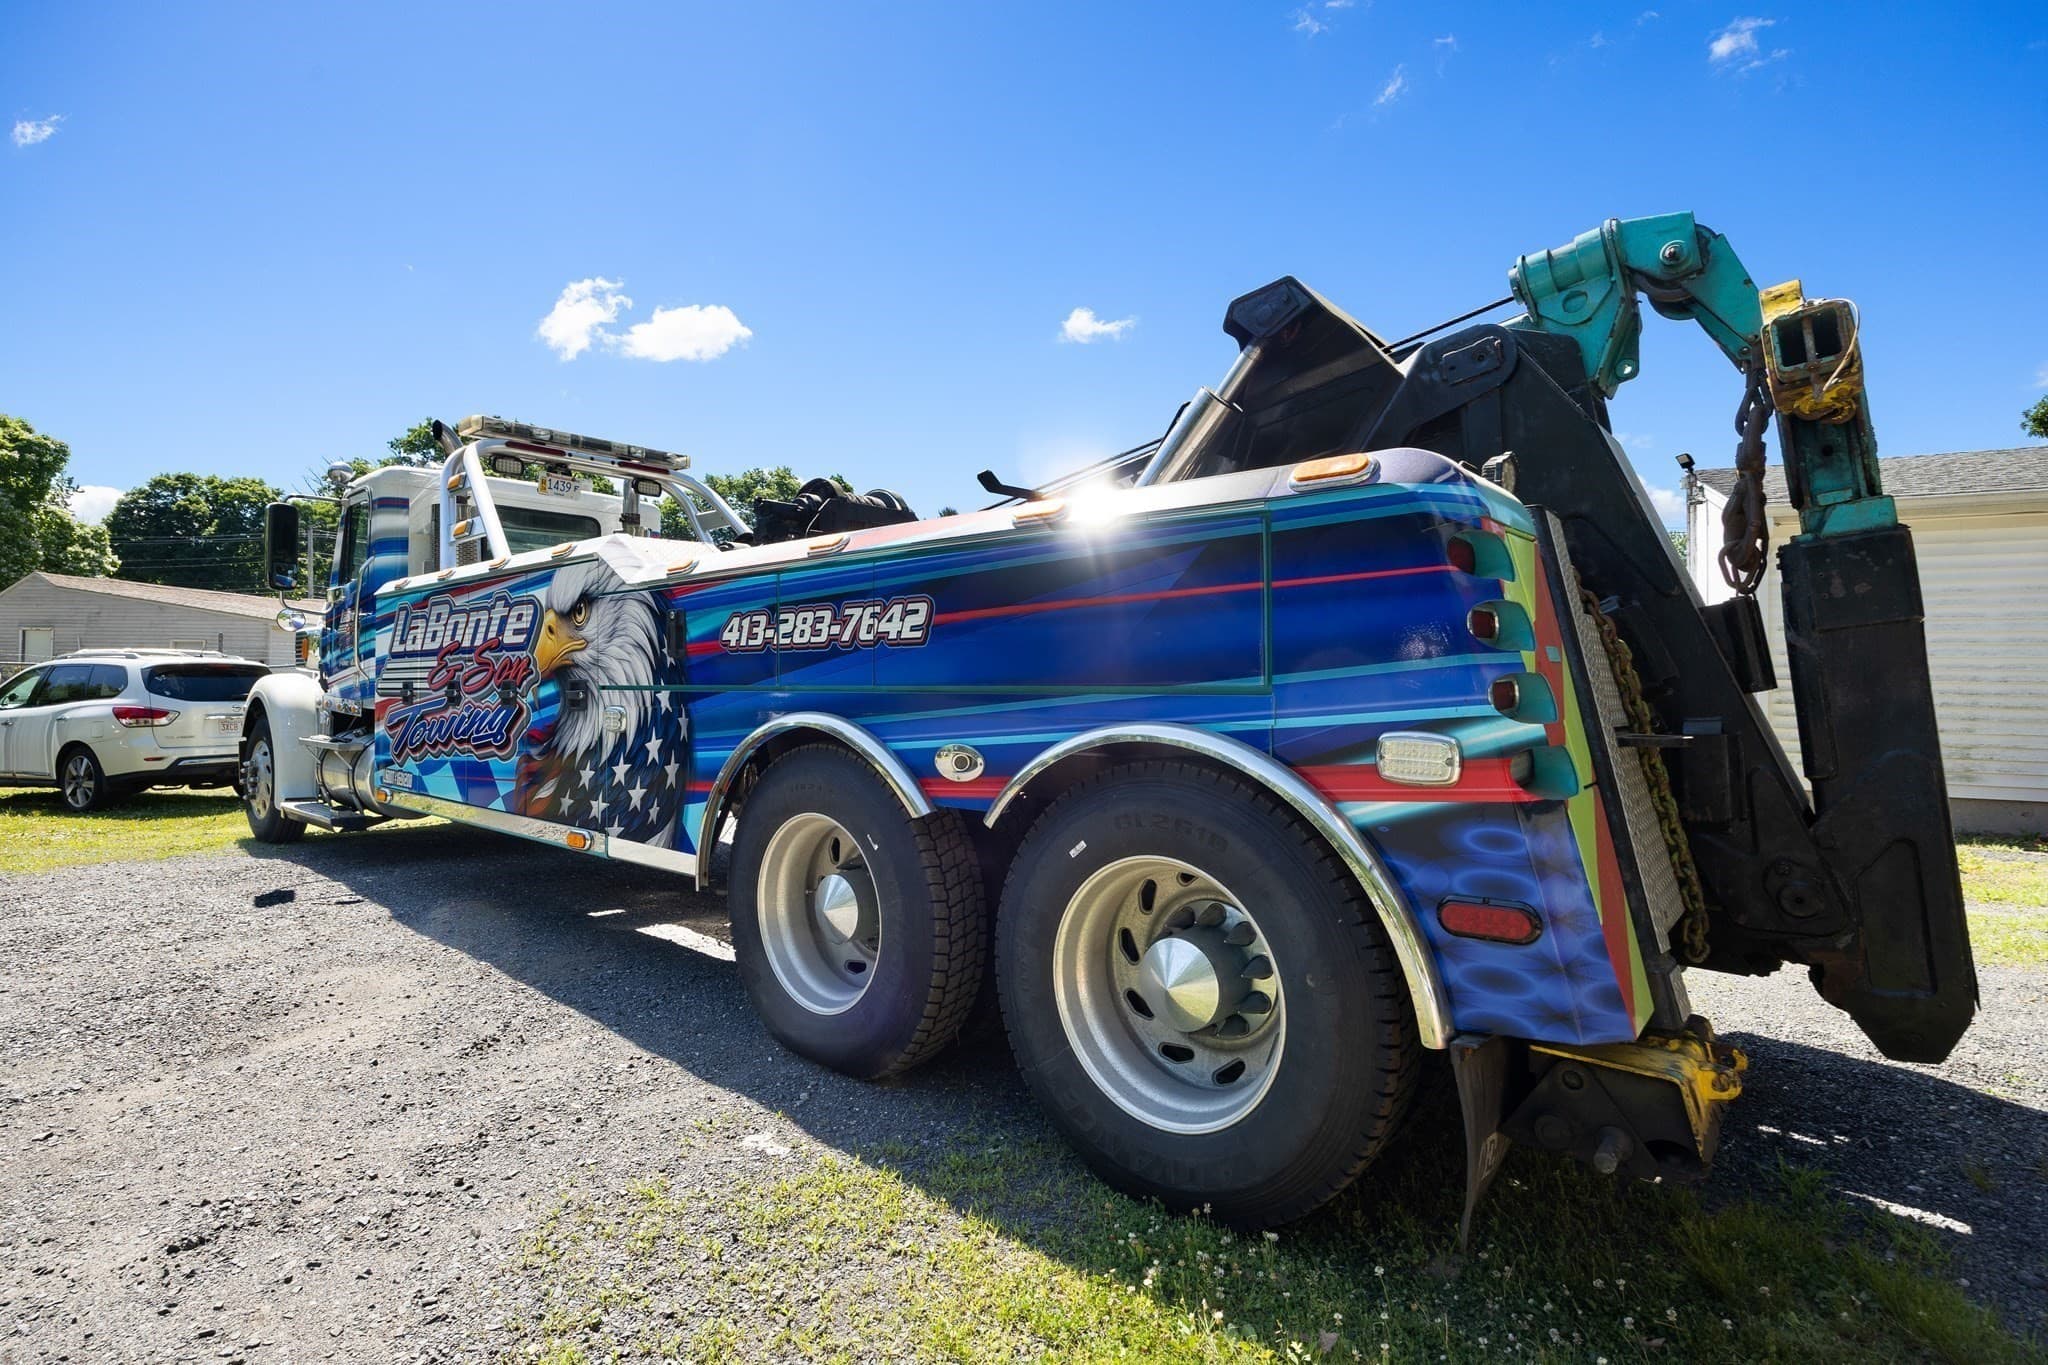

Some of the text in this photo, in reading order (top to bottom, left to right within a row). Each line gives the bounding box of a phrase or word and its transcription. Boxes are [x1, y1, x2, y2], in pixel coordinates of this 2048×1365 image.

[548, 478, 572, 493] 1439
[391, 600, 535, 653] LaBonte
[721, 600, 930, 649] 413-283-7642
[461, 637, 533, 694] Son
[386, 696, 519, 755] Towing
